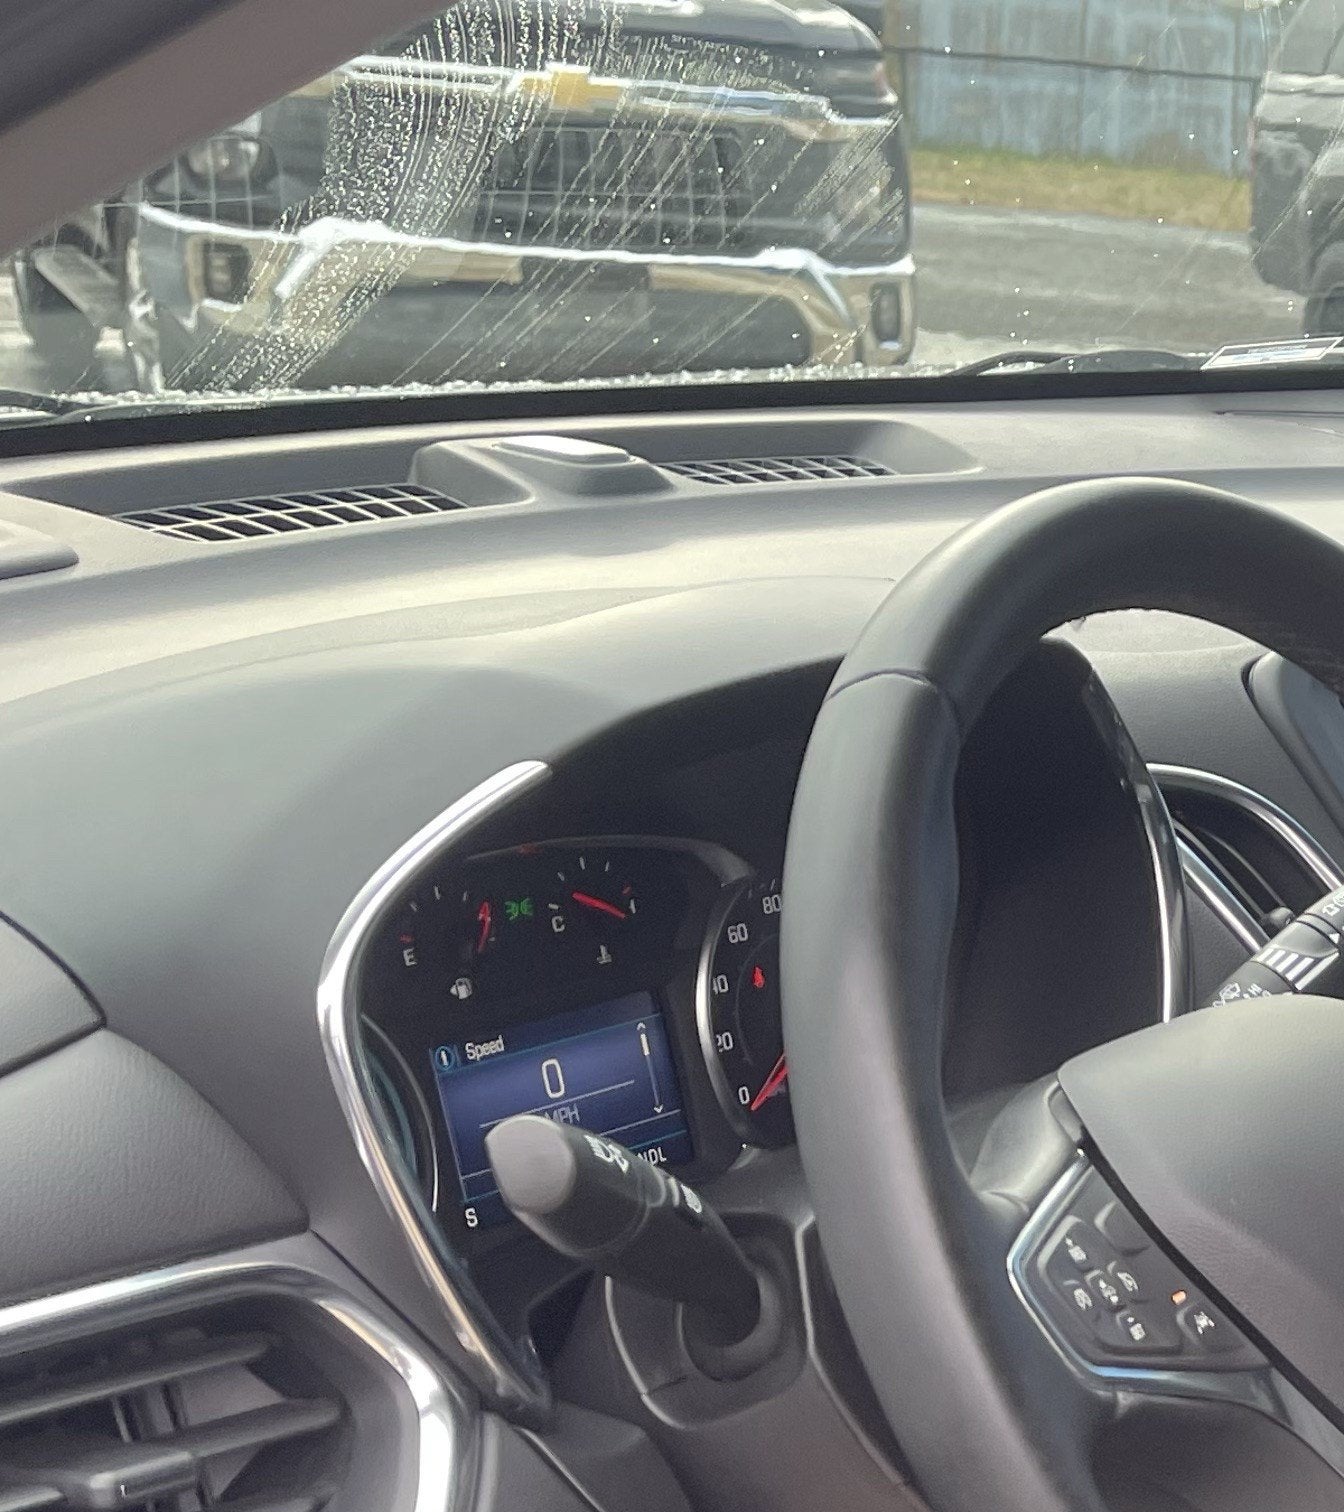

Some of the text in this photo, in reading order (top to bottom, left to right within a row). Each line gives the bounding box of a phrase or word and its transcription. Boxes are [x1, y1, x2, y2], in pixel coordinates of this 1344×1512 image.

[762, 894, 782, 914] 80
[551, 916, 565, 933] C
[727, 923, 748, 943] 60
[403, 949, 416, 967] E
[464, 1034, 505, 1061] Speed
[541, 1058, 566, 1099] 0
[738, 1086, 750, 1104] 0
